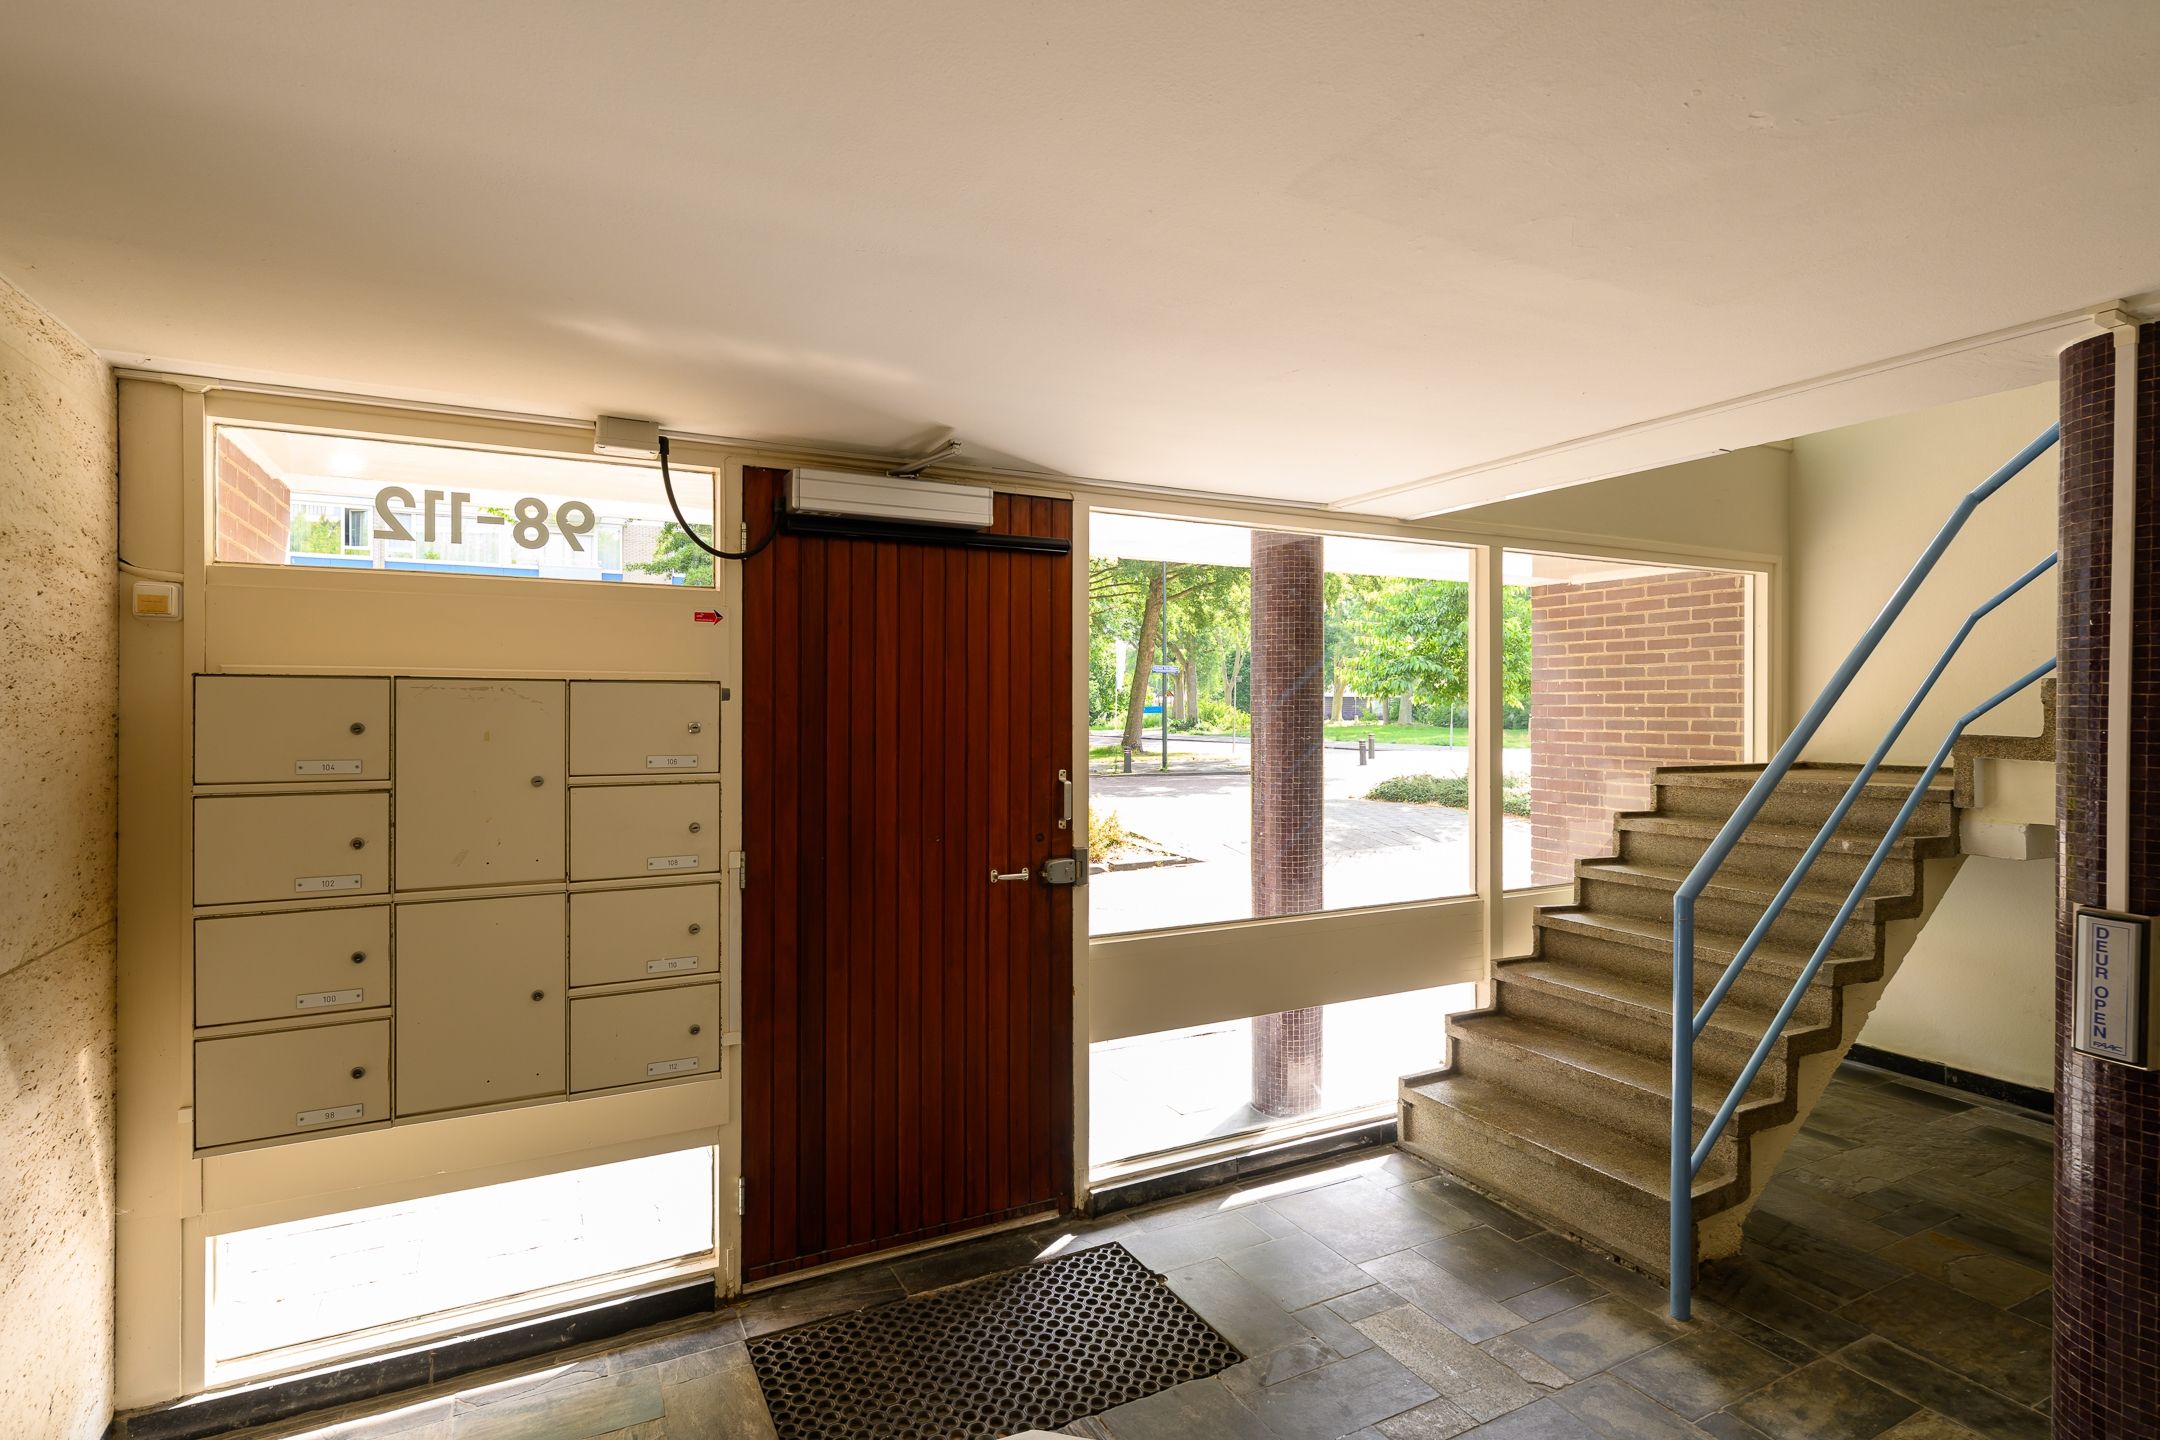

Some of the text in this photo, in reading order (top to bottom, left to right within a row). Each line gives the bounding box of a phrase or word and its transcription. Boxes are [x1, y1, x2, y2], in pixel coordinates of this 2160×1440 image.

[321, 763, 335, 771] 104
[321, 880, 335, 888] 102
[667, 961, 678, 969] 110
[2093, 926, 2110, 1039] DEUR OPEN
[322, 995, 337, 1004] 100
[324, 1111, 335, 1120] 98
